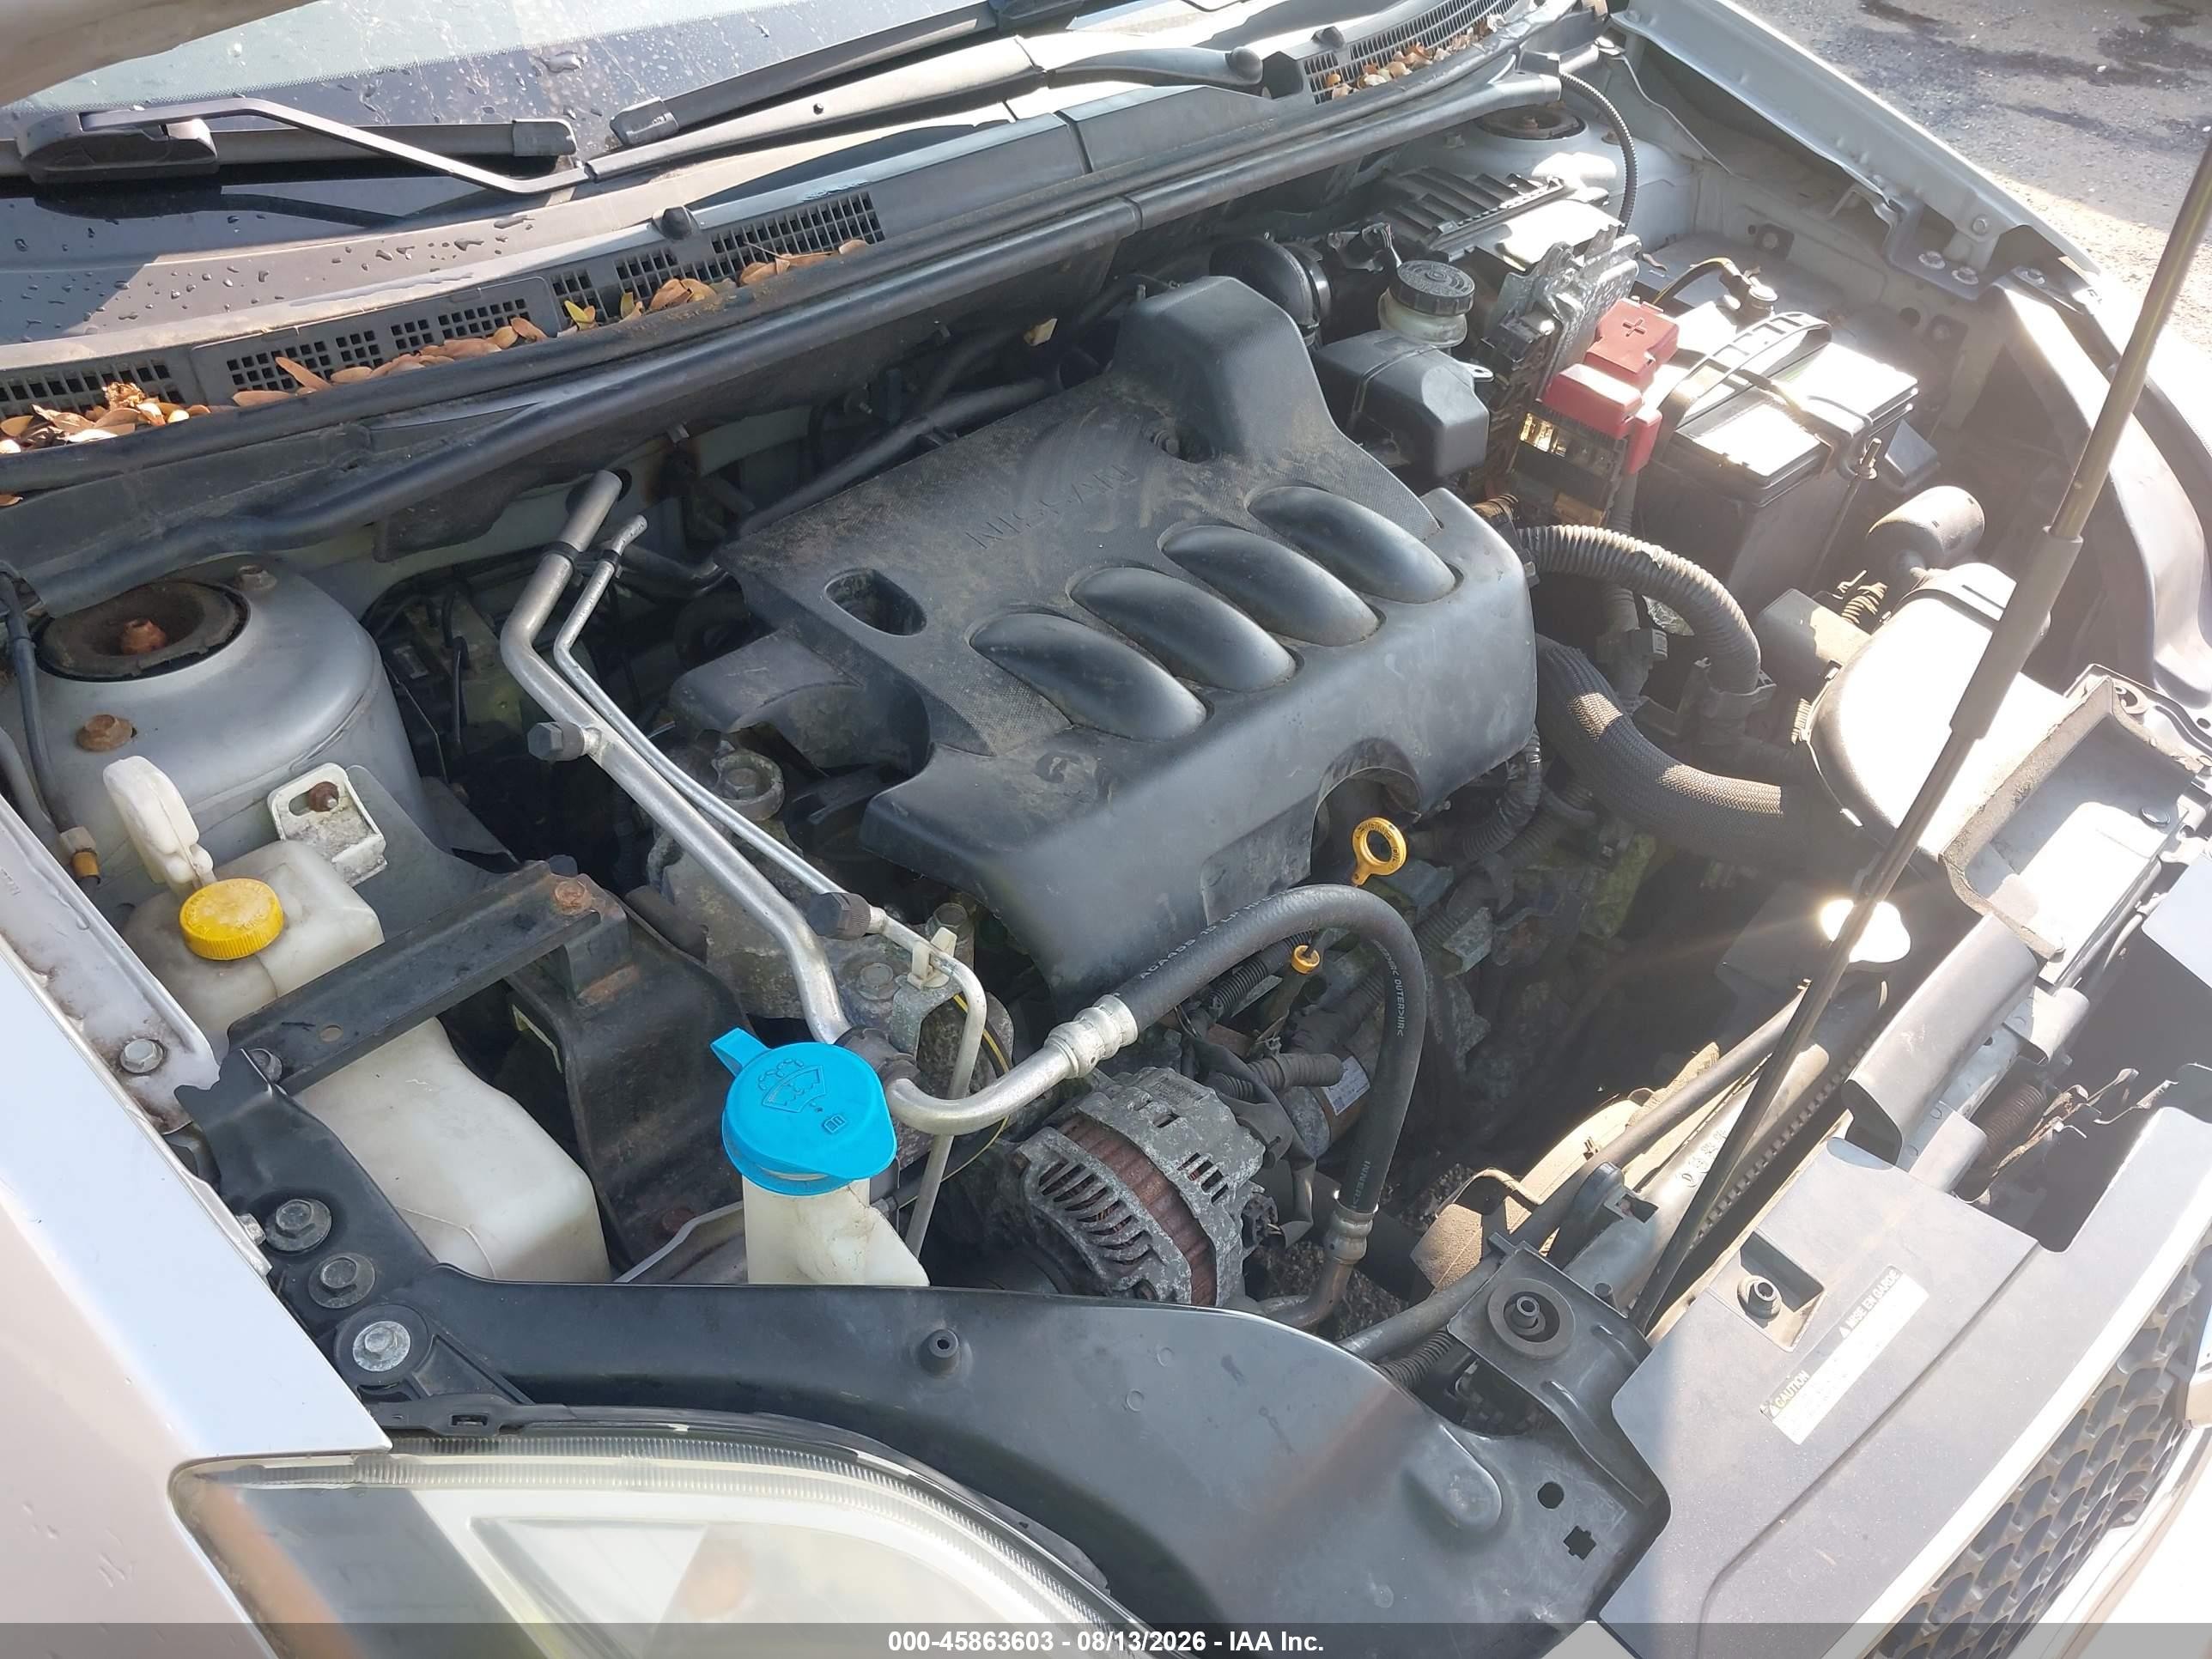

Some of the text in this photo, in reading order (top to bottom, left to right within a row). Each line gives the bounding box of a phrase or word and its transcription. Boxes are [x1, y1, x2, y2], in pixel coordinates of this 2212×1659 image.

[1845, 1269, 1900, 1329] MISE EN GARDE
[1775, 1370, 1810, 1409] CAUTION
